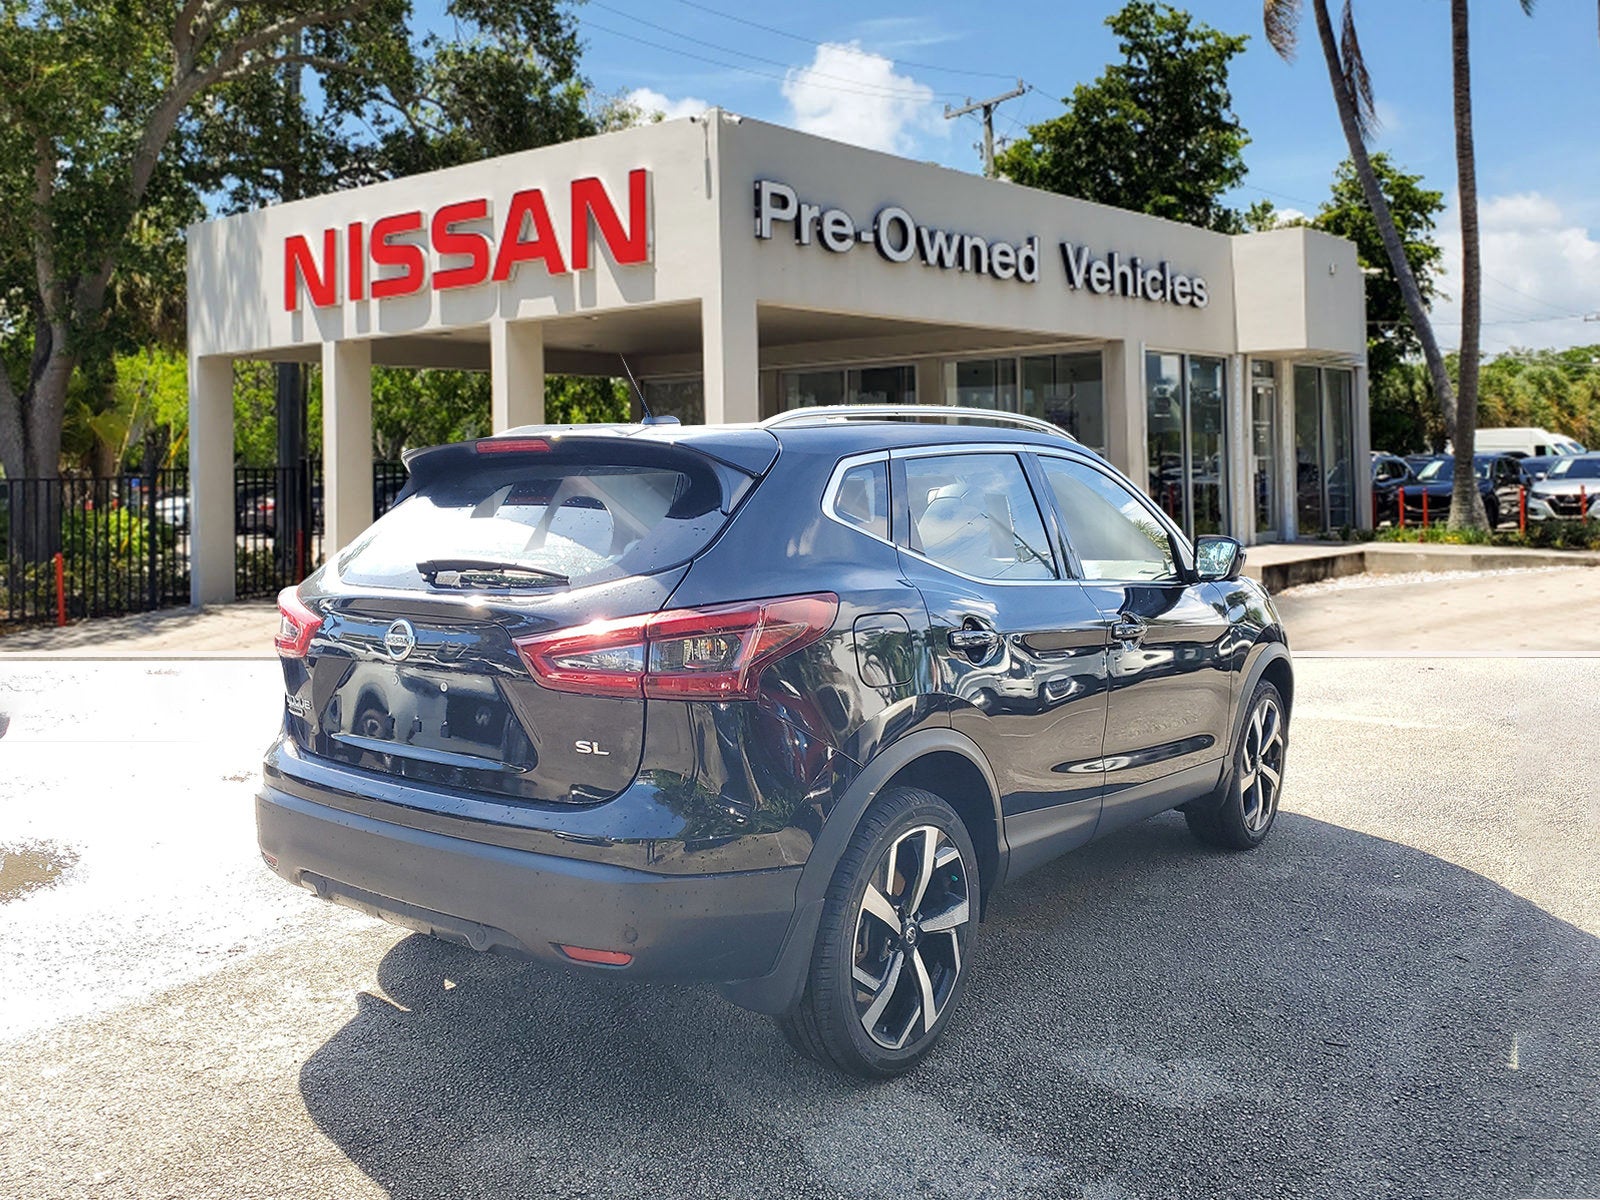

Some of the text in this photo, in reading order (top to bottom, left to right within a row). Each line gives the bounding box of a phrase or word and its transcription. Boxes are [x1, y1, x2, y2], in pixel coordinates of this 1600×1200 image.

[285, 169, 648, 312] NISSAN
[755, 180, 1208, 308] Pre-Owned Vehicles
[575, 740, 610, 756] SL
